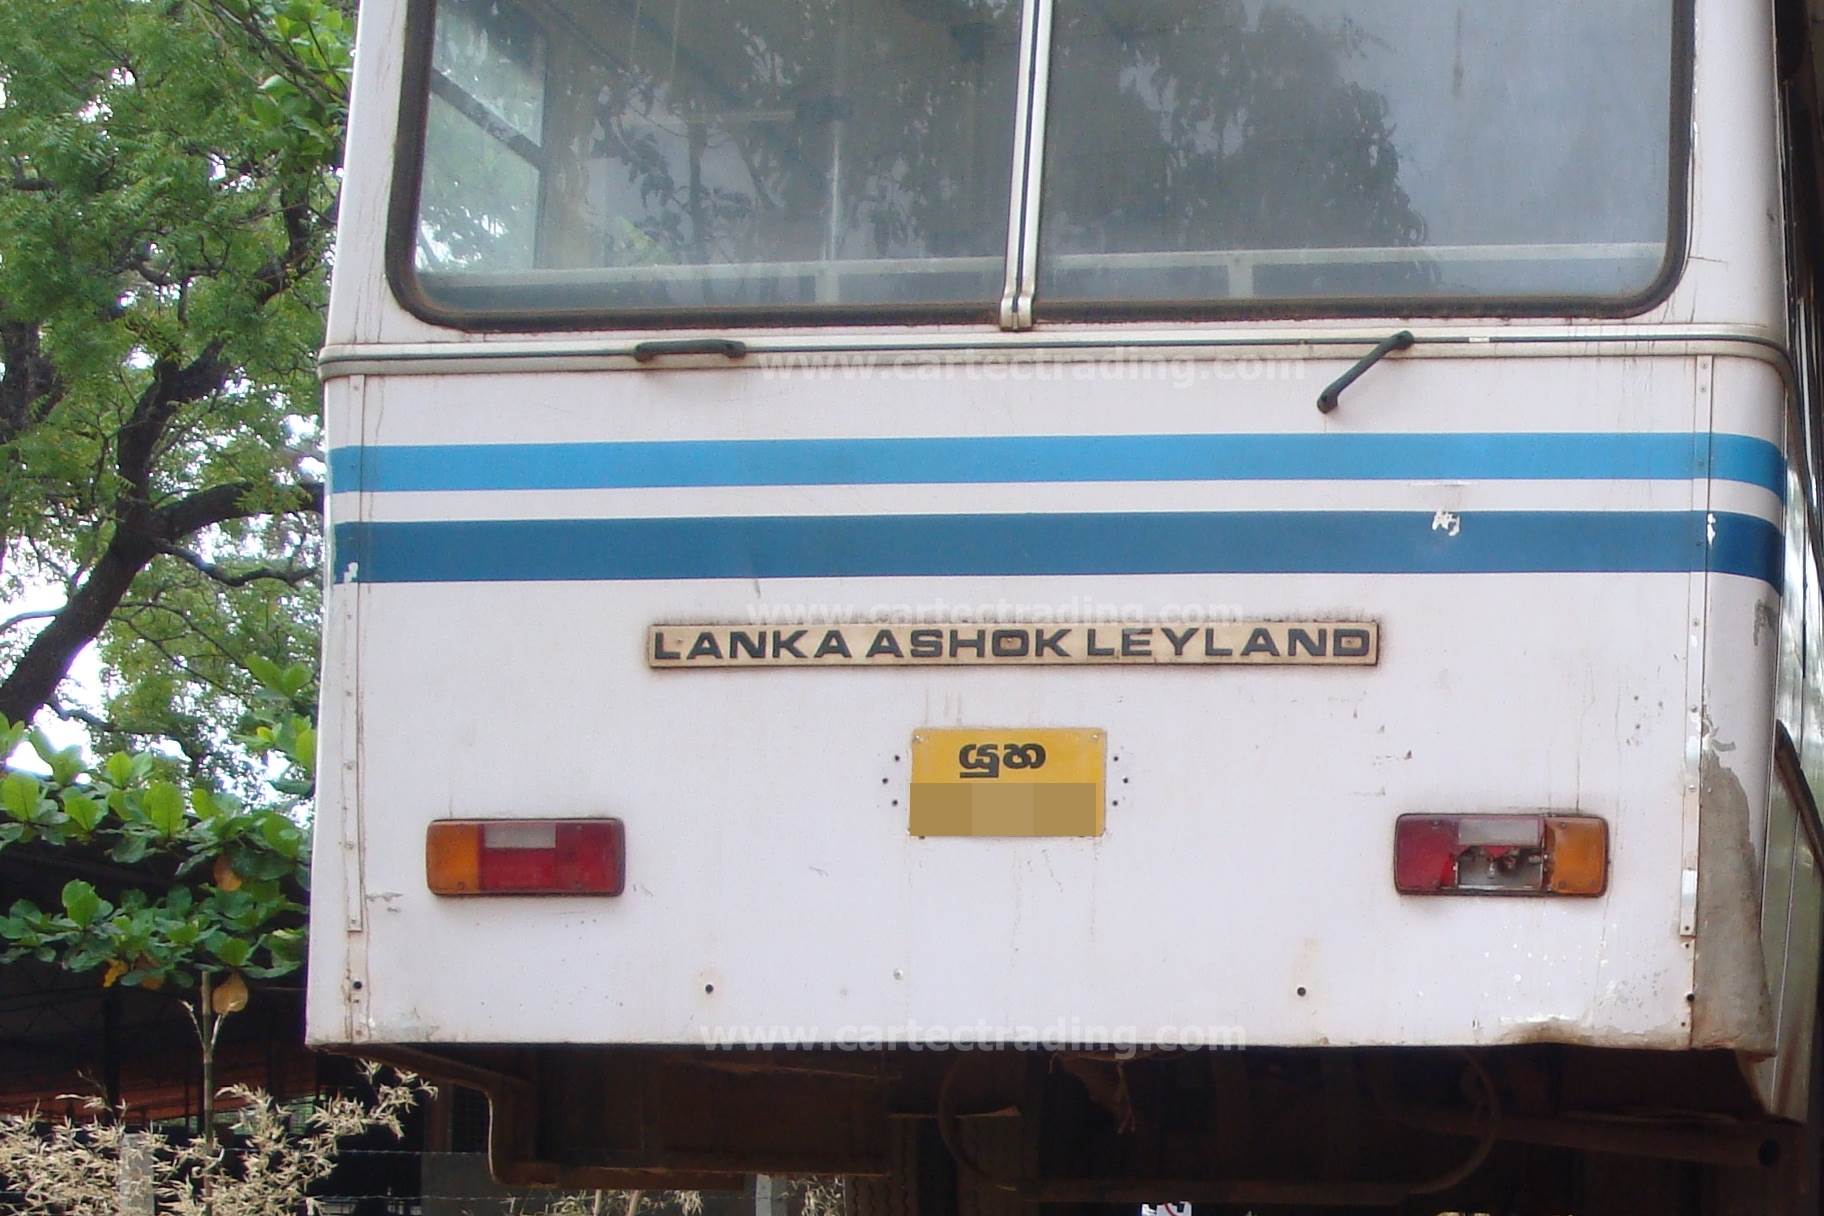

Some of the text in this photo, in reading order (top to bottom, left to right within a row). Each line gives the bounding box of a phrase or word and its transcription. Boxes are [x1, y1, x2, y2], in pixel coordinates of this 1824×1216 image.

[653, 627, 1371, 662] LANKA ASHOK LEYLAND
